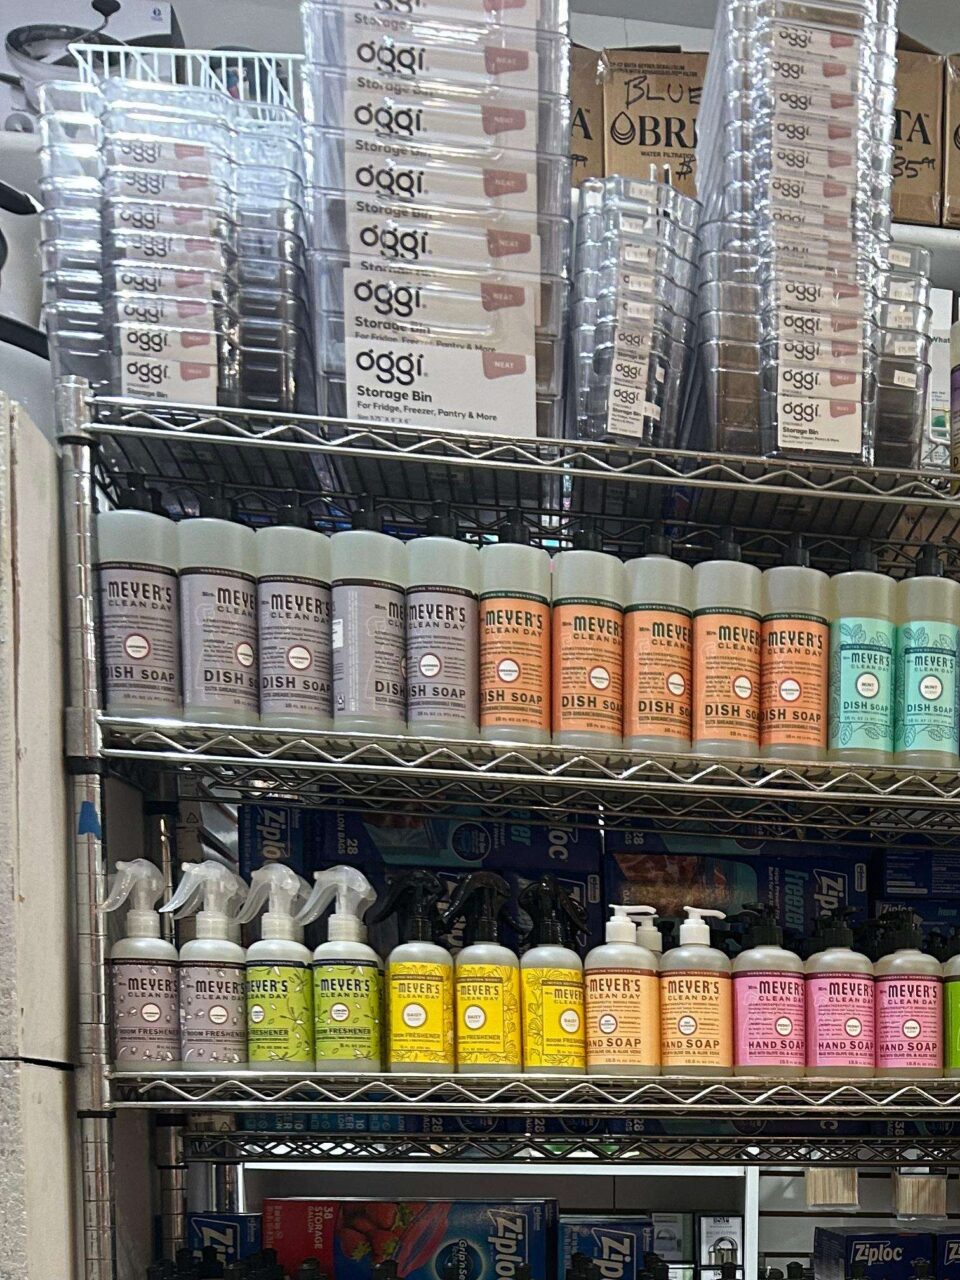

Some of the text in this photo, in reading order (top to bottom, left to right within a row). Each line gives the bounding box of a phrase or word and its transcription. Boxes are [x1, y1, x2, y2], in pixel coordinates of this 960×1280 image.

[624, 76, 702, 109] BLUE
[639, 116, 698, 148] BRI
[356, 349, 424, 385] oggi
[494, 361, 514, 369] NEAT
[783, 369, 820, 390] oggi
[357, 386, 432, 403] Storage Bin
[357, 401, 497, 421] For Fridge, Freezer, Pantry & More
[783, 402, 819, 422] oggi
[782, 426, 807, 435] Storage
[108, 581, 172, 602] MEYER'S
[485, 610, 542, 629] MEYER'S
[768, 630, 823, 648] MEYER'S
[562, 695, 597, 709] DISH
[320, 979, 370, 992] MEYER'S
[590, 979, 641, 993] MEYER'S
[888, 985, 938, 999] MEYER'S
[606, 1038, 641, 1048] SOAP
[909, 1042, 938, 1051] SOAP
[855, 1244, 904, 1266] Ziploc
